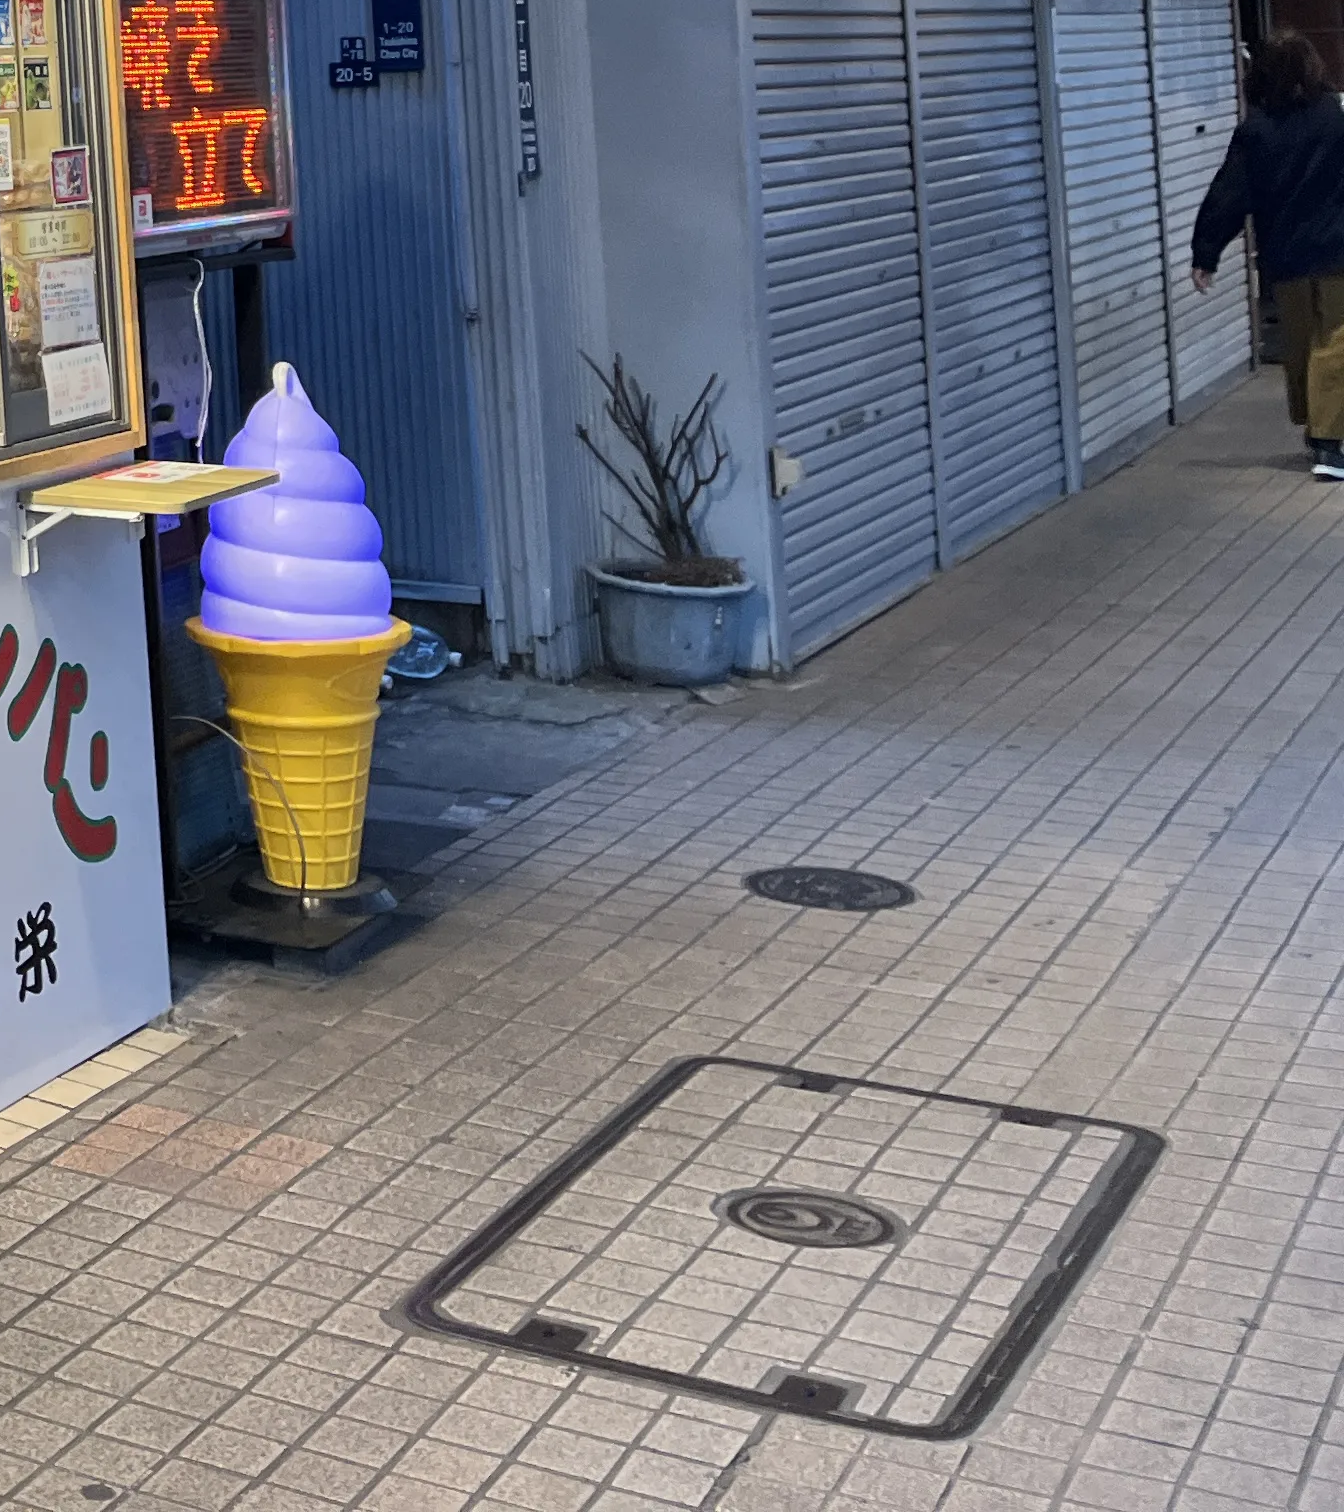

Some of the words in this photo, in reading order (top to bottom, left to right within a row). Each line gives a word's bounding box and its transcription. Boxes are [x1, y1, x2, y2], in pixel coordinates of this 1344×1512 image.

[383, 21, 414, 34] 1-20
[335, 67, 373, 83] 20-5
[171, 106, 268, 210] 立て
